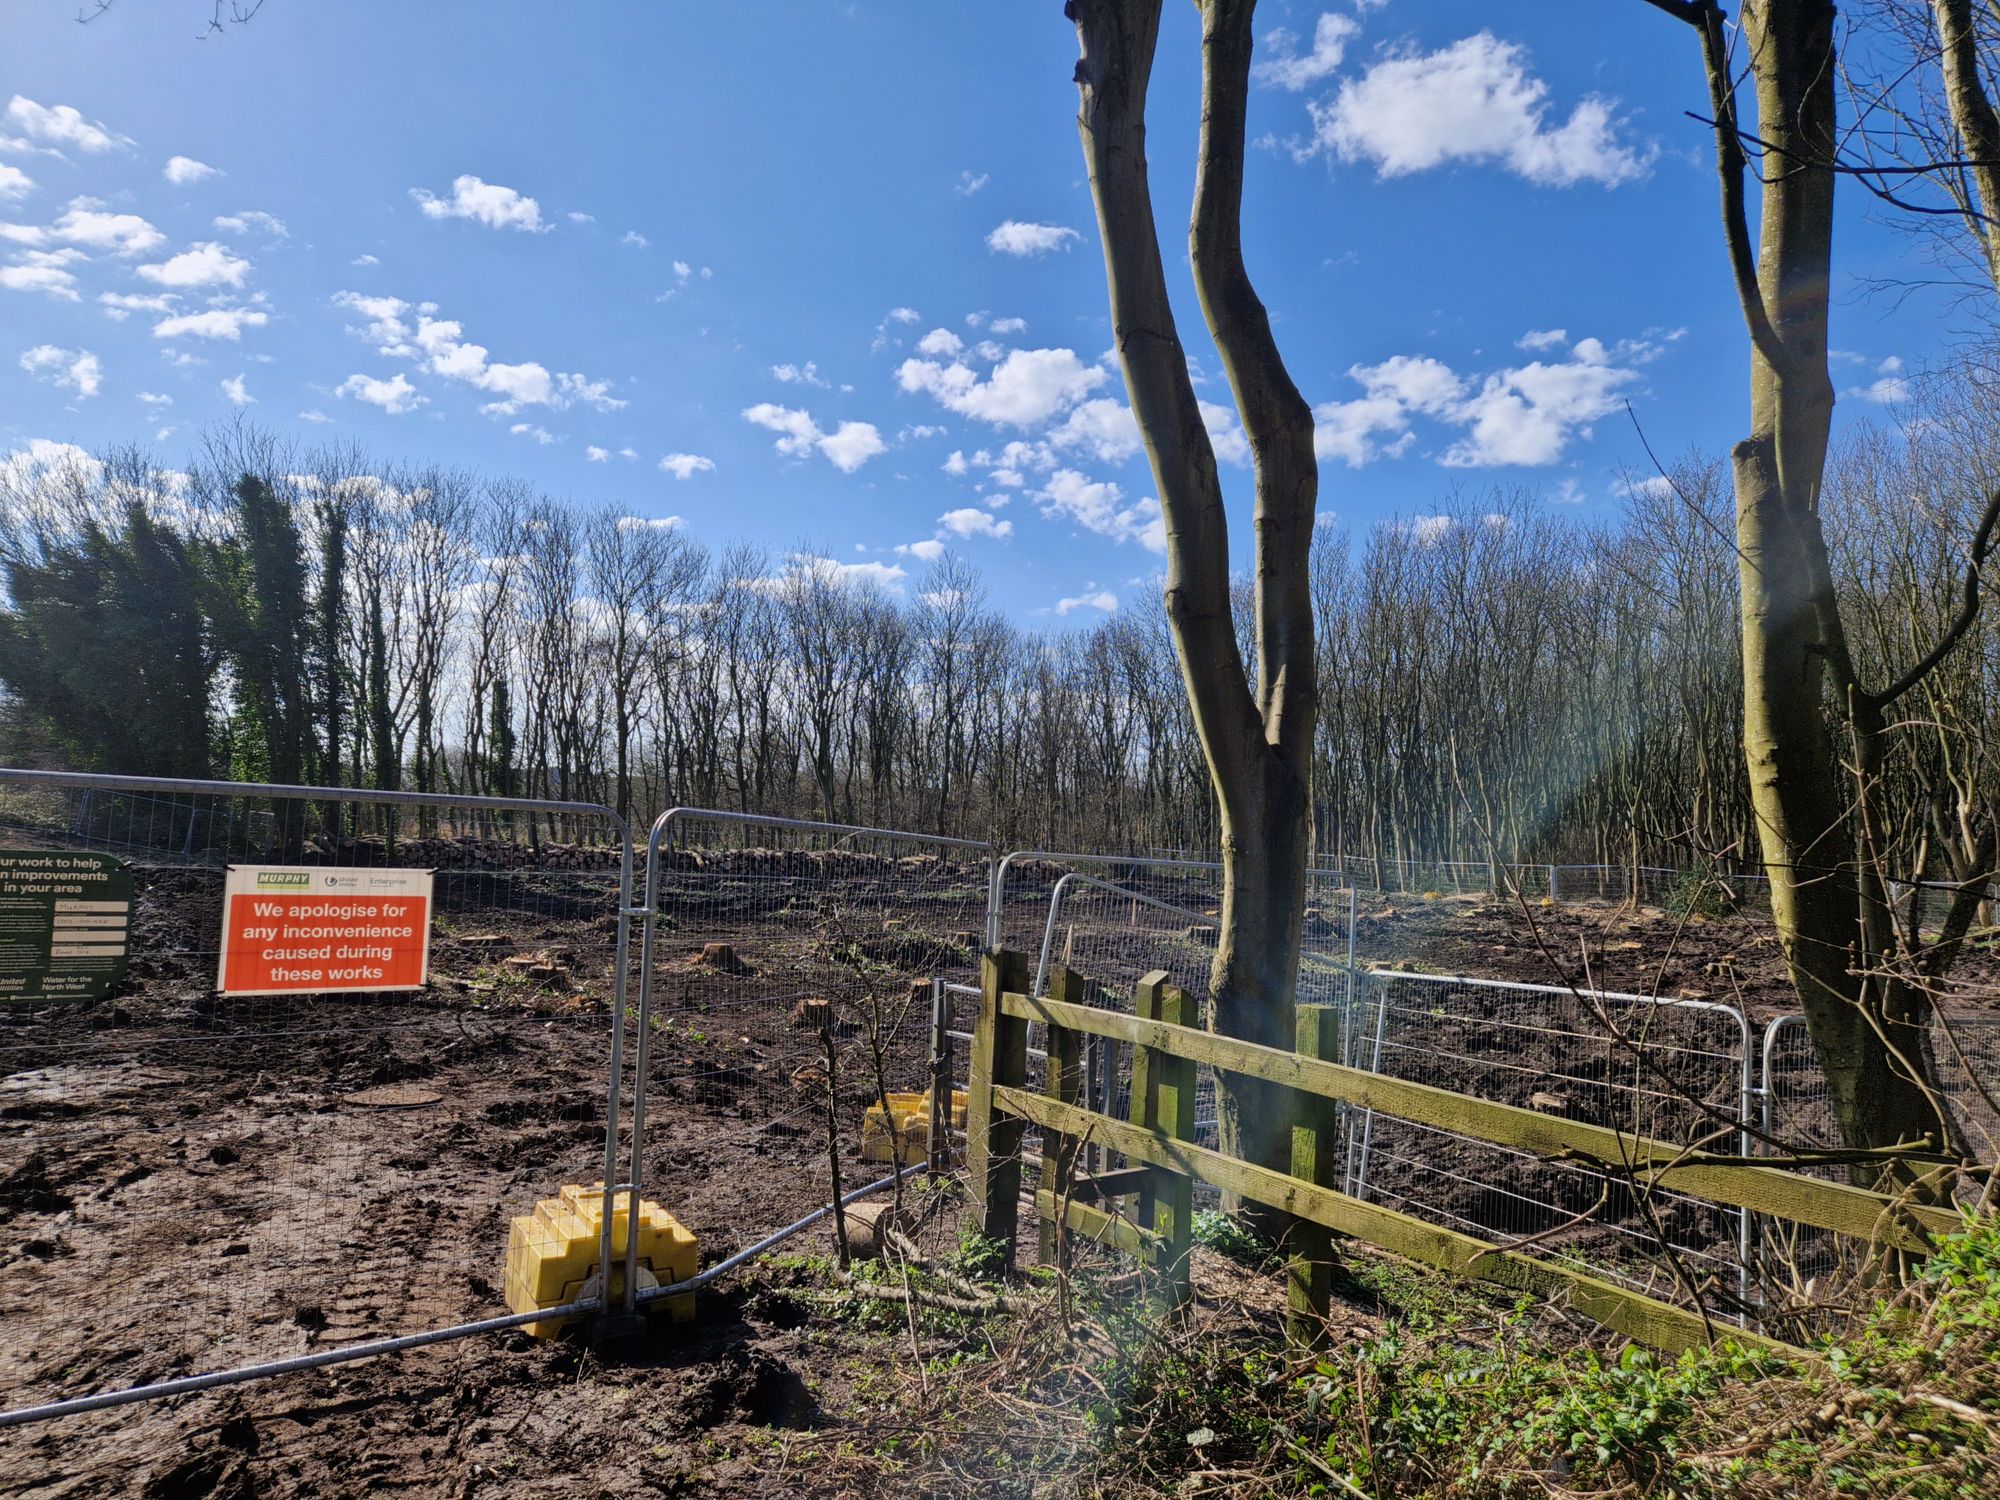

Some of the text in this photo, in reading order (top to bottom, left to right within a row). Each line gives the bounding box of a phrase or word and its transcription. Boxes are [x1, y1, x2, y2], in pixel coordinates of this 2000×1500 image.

[0, 857, 102, 870] ur work to help
[12, 869, 109, 882] improvements
[258, 873, 308, 884] MURPHY
[369, 877, 407, 886] Enterprise
[4, 882, 83, 895] in your area
[253, 902, 406, 920] We apologise for
[243, 924, 413, 942] any inconvenience
[262, 944, 393, 961] caused during
[80, 975, 93, 983] the
[271, 965, 383, 982] these works
[41, 983, 64, 991] North
